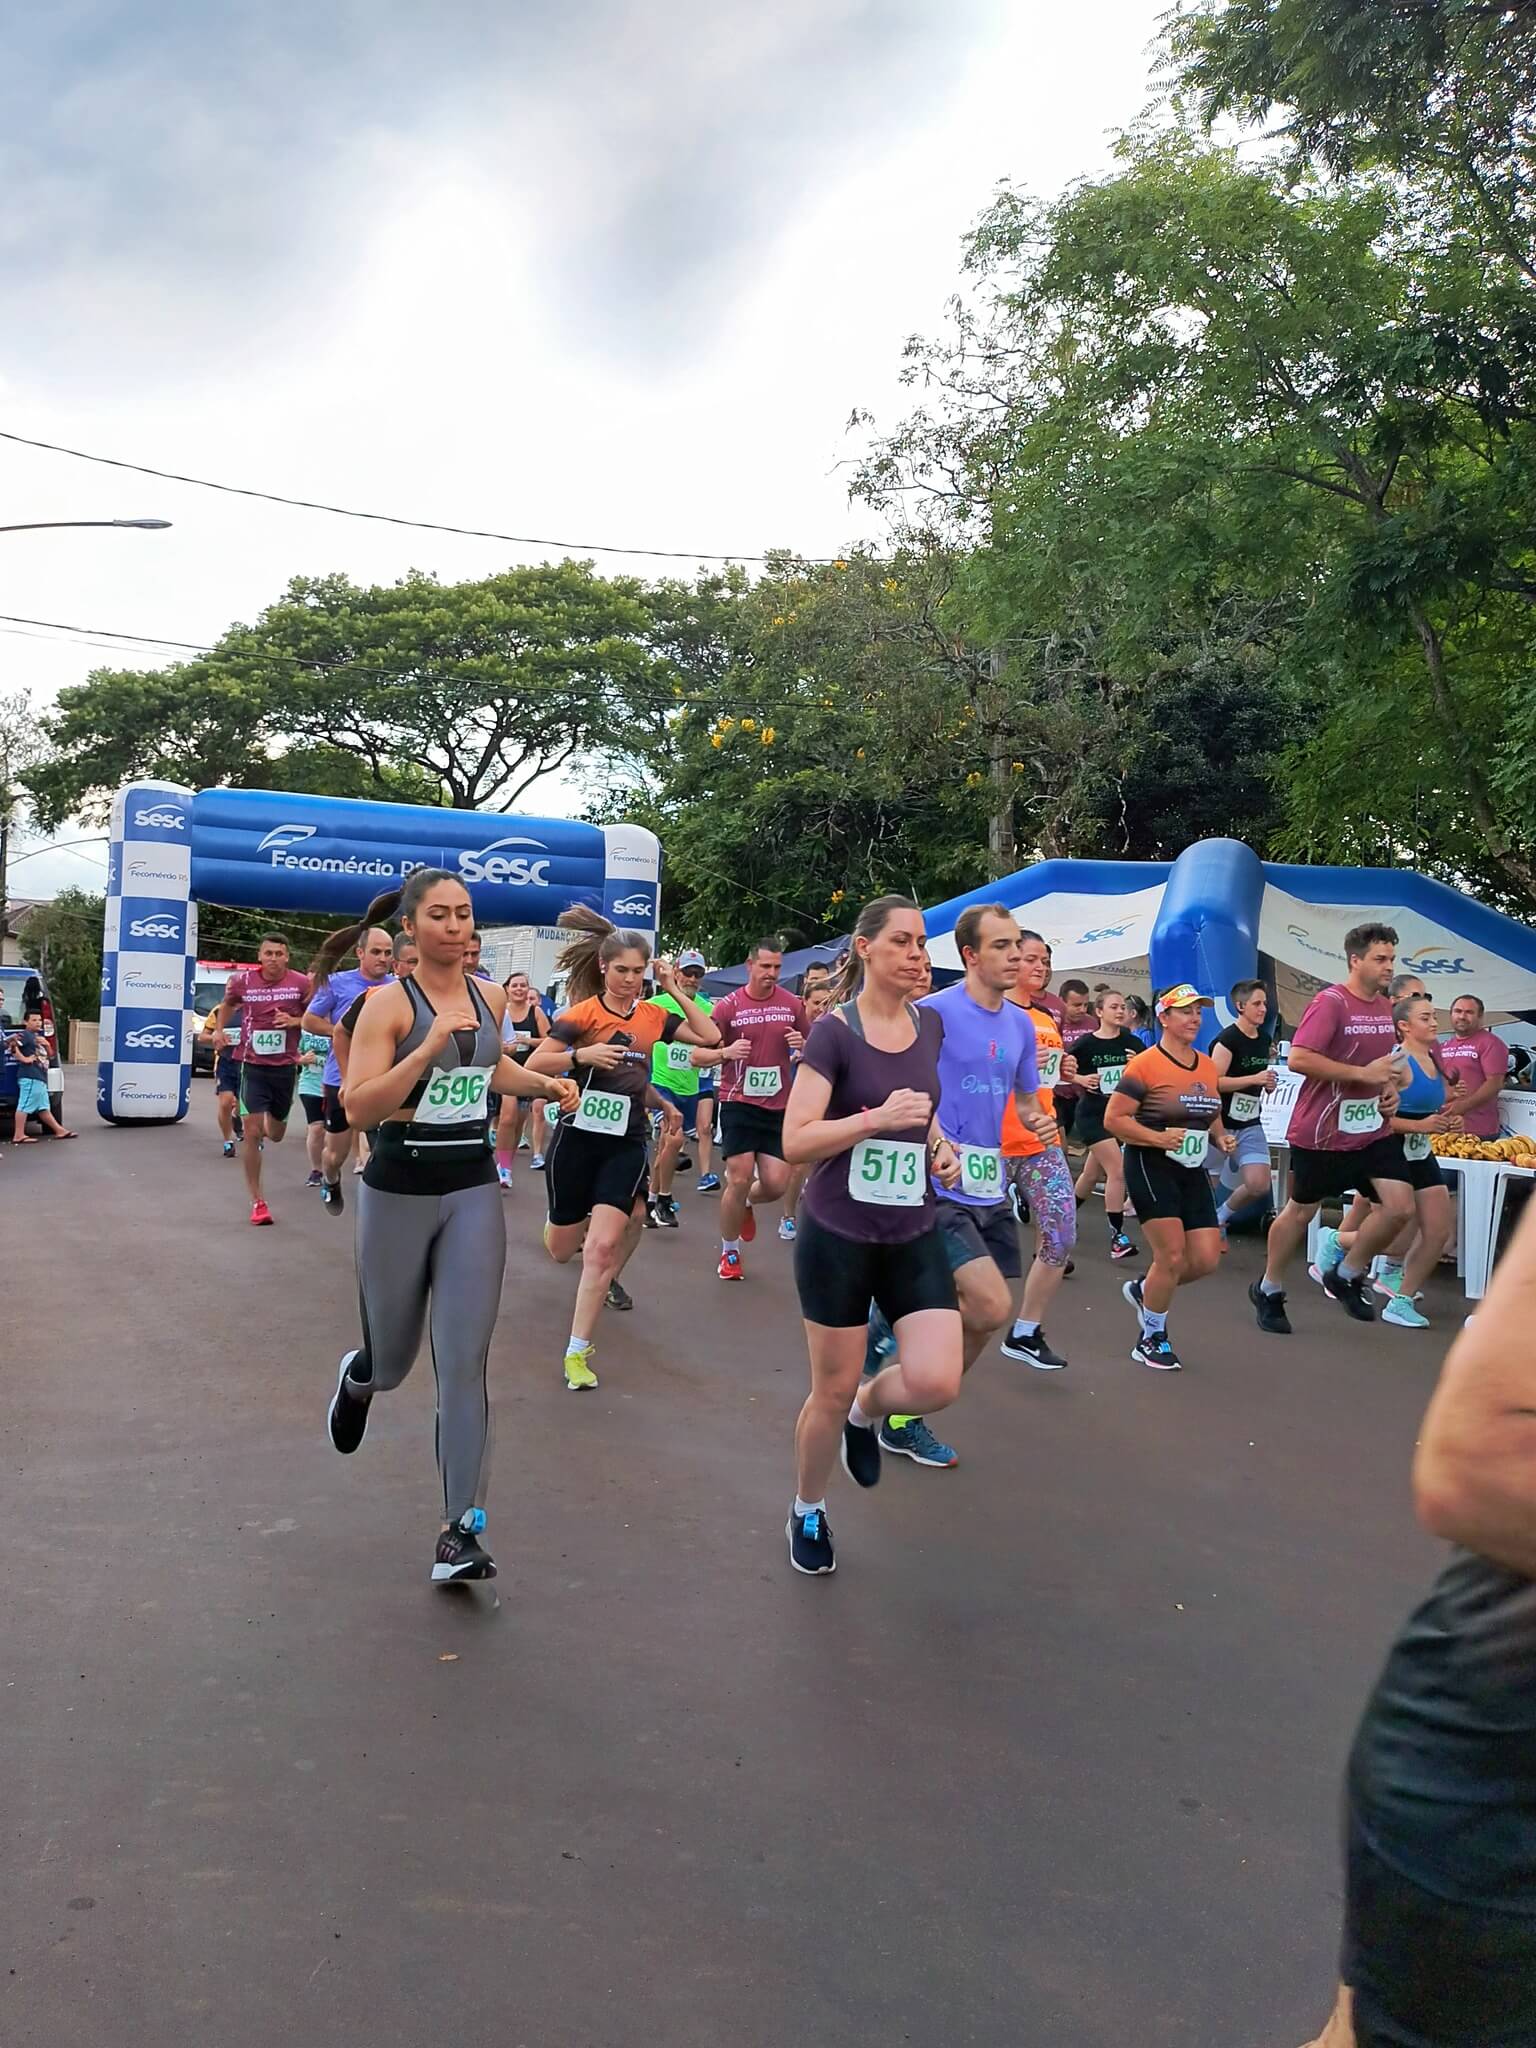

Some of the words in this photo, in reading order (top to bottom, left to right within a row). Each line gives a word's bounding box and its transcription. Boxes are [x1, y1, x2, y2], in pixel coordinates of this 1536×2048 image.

[271, 850, 394, 877] Fecomércio
[256, 1034, 282, 1047] 443
[429, 1074, 485, 1106] 596
[749, 1071, 777, 1088] 672
[583, 1096, 624, 1122] 688
[1235, 1098, 1257, 1114] 557
[1344, 1103, 1376, 1122] 564
[862, 1148, 916, 1185] 513
